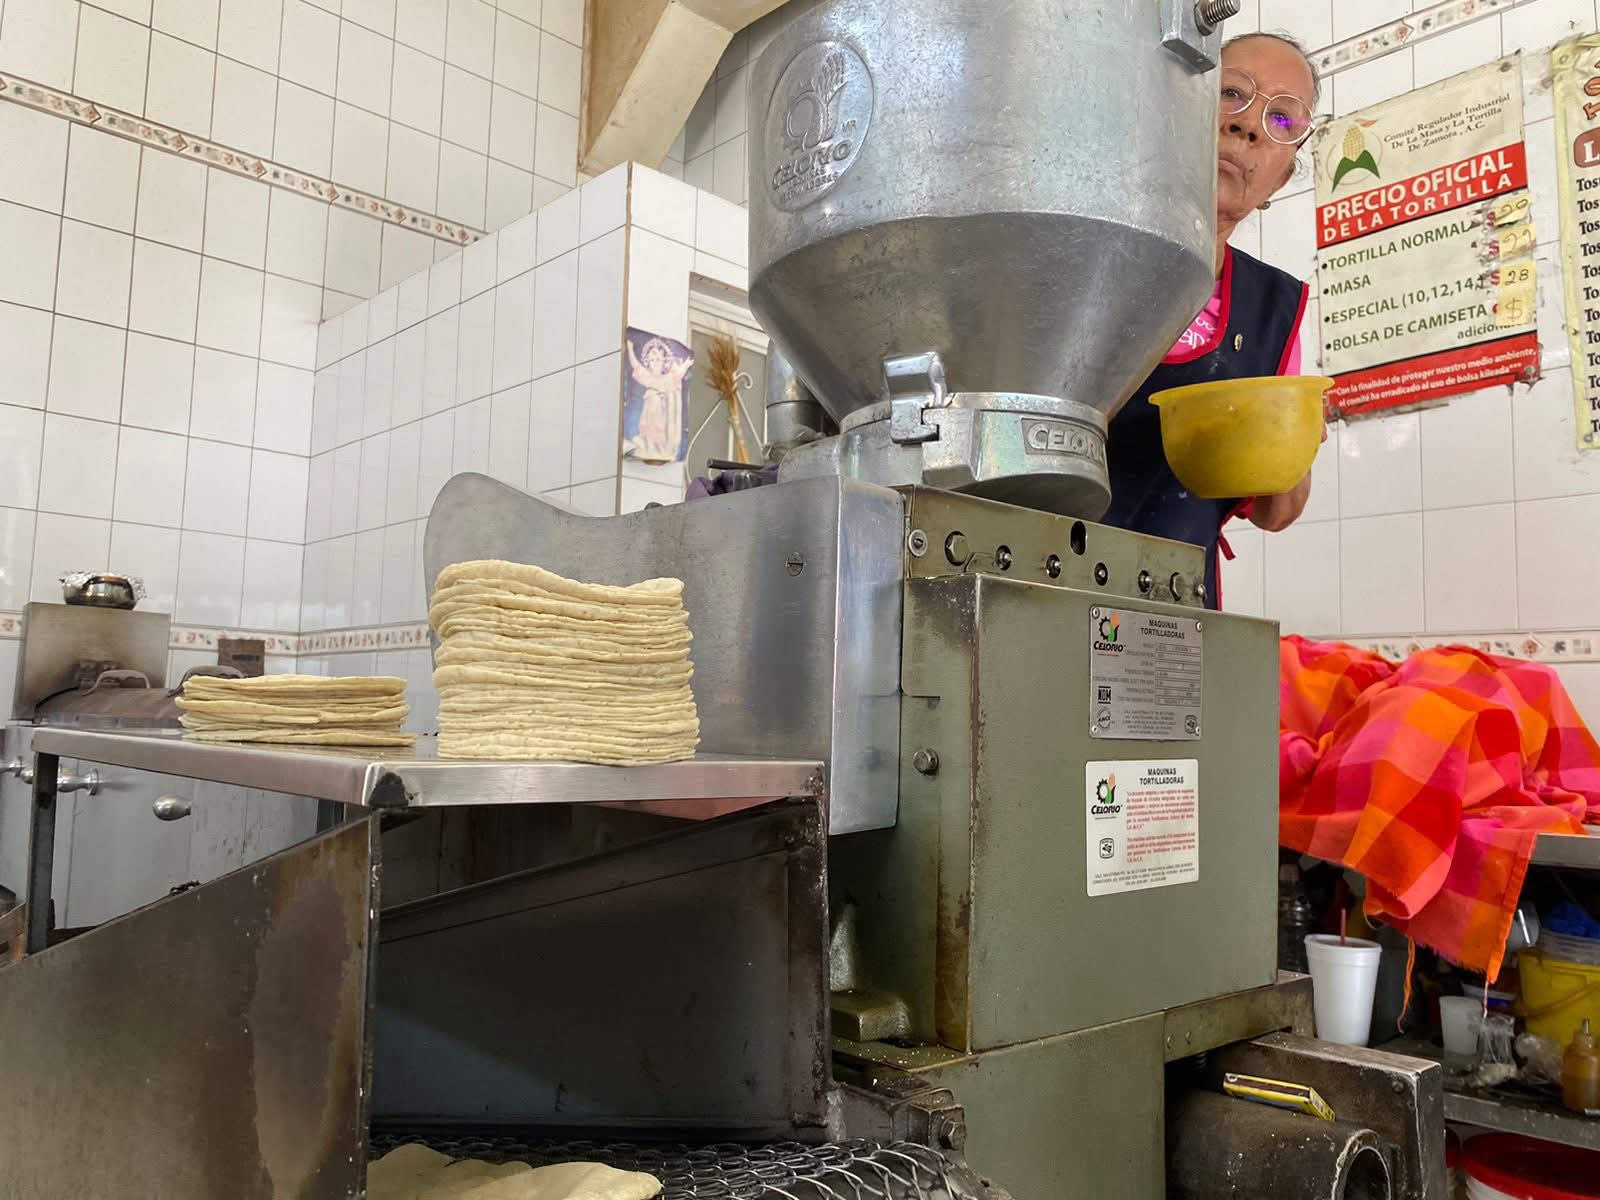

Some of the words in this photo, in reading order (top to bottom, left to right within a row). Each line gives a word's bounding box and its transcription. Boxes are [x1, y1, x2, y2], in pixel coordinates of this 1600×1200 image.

[1417, 111, 1462, 131] Regulador
[1465, 93, 1510, 114] Industrial
[1392, 141, 1403, 149] De
[1407, 136, 1417, 144] La
[1420, 128, 1443, 139] Masa
[1467, 107, 1502, 122] Tortilla
[1409, 144, 1420, 152] De
[1322, 185, 1407, 226] PRECIO
[1411, 150, 1513, 197] OFICIAL
[1323, 224, 1350, 243] DE
[1358, 213, 1384, 232] LA
[1390, 172, 1513, 221] TORTILLA
[1328, 242, 1397, 271] TORTILLA
[1401, 220, 1469, 249] NORMAL
[1330, 275, 1371, 297] MASA
[1331, 298, 1399, 324] ESPECIAL
[1332, 328, 1380, 352] BOLSA
[1384, 323, 1404, 340] DE
[1407, 303, 1488, 334] CAMISETA
[1468, 356, 1493, 368] medio
[1457, 372, 1479, 384] bolsa
[1140, 627, 1185, 640] TORTILLADORAS
[1139, 777, 1184, 786] TORTILLADORAS
[1147, 768, 1177, 776] MAQUINAS
